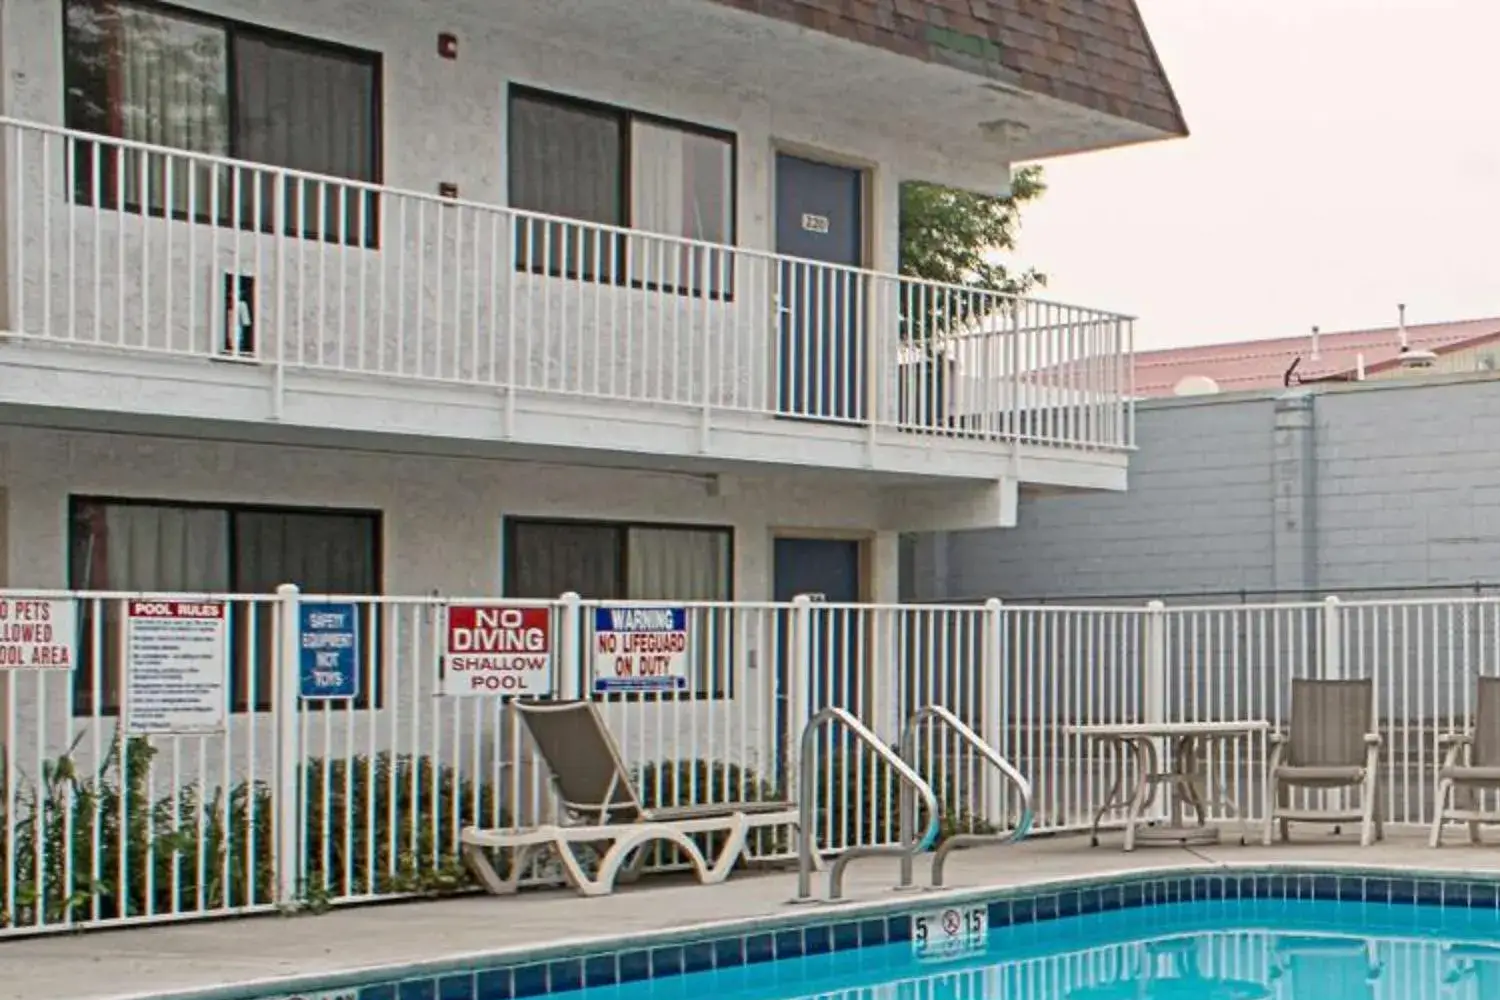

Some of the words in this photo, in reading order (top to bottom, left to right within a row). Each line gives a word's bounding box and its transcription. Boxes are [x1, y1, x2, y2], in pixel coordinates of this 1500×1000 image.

[0, 600, 9, 620] O
[15, 601, 50, 620] PETS
[134, 602, 173, 616] POOL
[177, 603, 219, 617] RULES
[475, 609, 523, 629] NO
[611, 608, 674, 630] WARNING
[0, 623, 53, 643] LOWED
[452, 627, 545, 651] DIVING
[599, 633, 617, 654] NO
[623, 633, 685, 653] LIFEGUARD
[0, 645, 25, 665] OOL
[31, 645, 69, 665] AREA
[451, 656, 546, 671] SHALLOW
[616, 656, 632, 676] ON
[640, 655, 671, 676] DUTY
[471, 675, 528, 690] POOL
